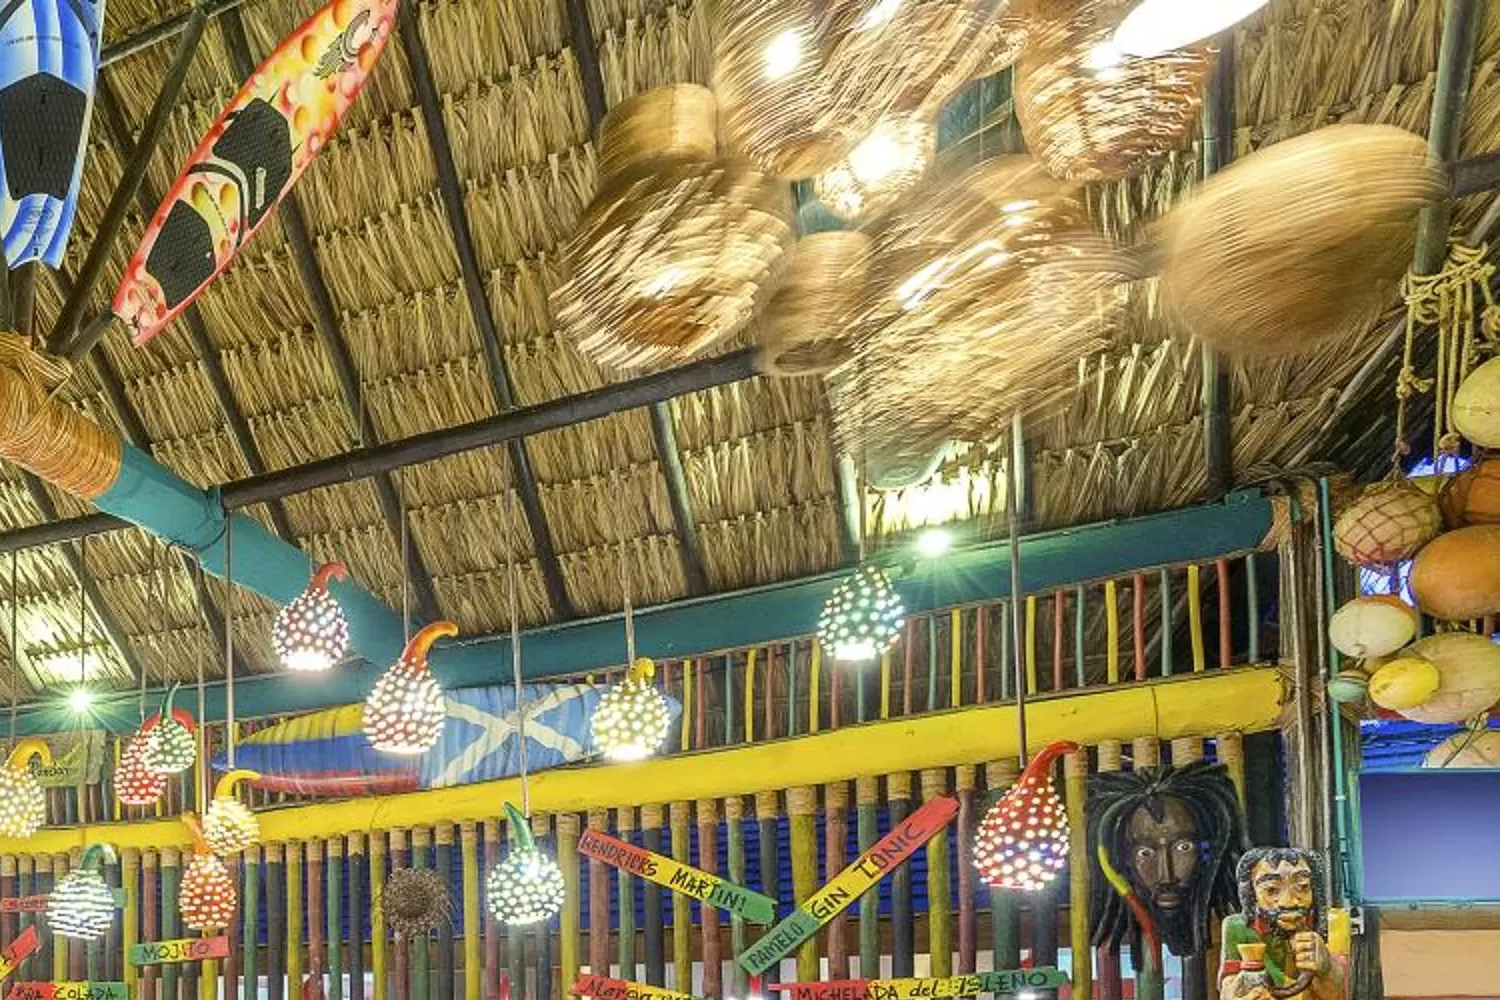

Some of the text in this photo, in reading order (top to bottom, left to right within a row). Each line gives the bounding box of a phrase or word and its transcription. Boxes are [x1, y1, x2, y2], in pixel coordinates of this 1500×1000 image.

[810, 887, 850, 919] GIN
[853, 823, 923, 879] TONIC
[142, 943, 209, 961] MOJITO
[909, 979, 939, 998] del
